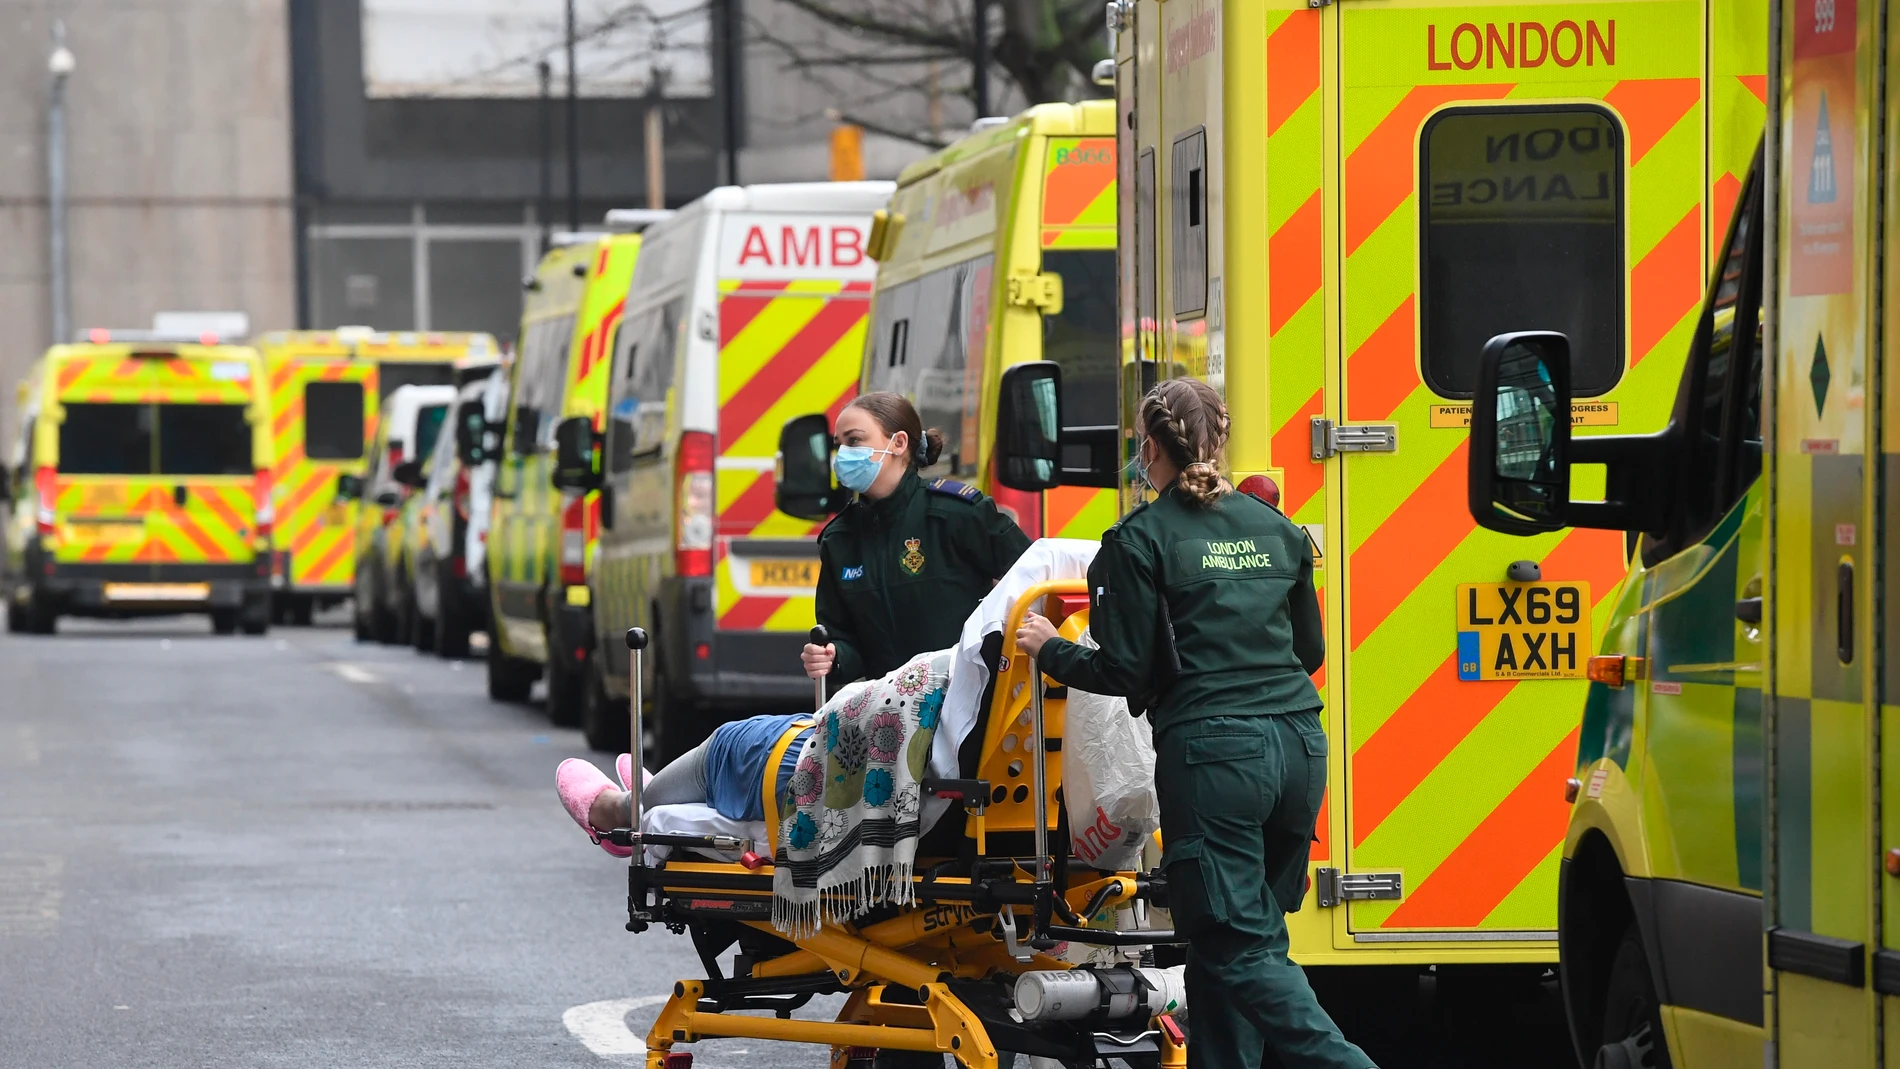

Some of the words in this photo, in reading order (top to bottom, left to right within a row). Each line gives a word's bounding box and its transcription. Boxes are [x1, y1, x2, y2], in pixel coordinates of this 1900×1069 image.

[1814, 0, 1835, 33] 999
[1427, 19, 1616, 71] LONDON
[1056, 147, 1112, 165] 8366
[738, 225, 864, 267] AMB
[1439, 407, 1472, 415] PATIEN
[1570, 416, 1584, 424] AIT
[1206, 540, 1257, 555] LONDON
[1202, 554, 1272, 570] AMBULANCE
[844, 565, 863, 579] NHS
[1469, 587, 1580, 625] LX69
[1494, 632, 1576, 670] AXH
[1462, 662, 1477, 673] GB
[1073, 806, 1122, 862] and
[691, 899, 734, 910] power
[1043, 970, 1098, 983] gen
